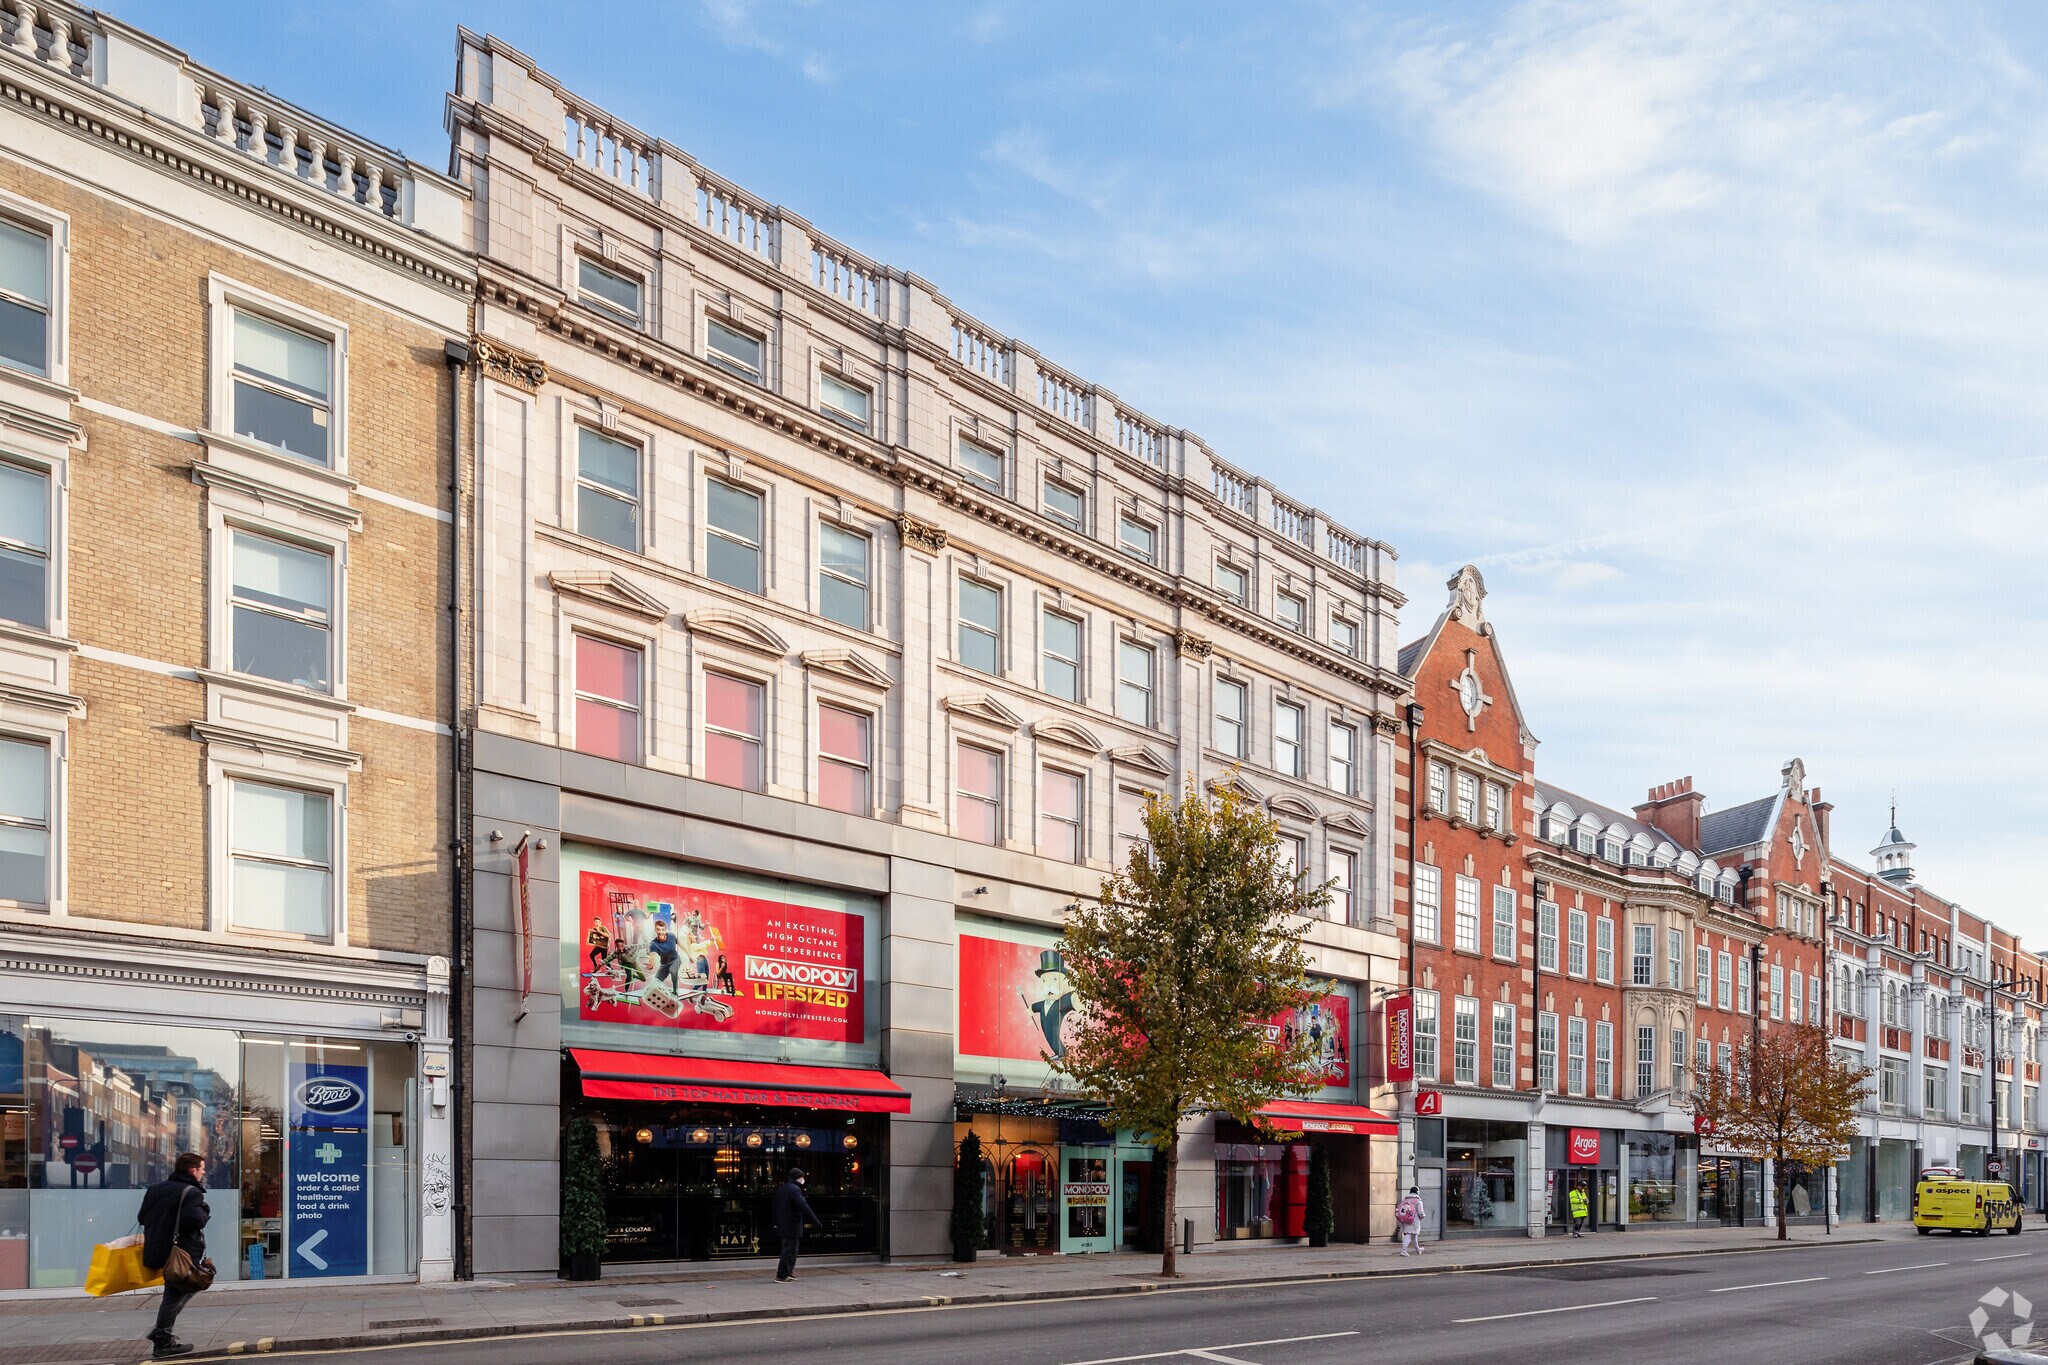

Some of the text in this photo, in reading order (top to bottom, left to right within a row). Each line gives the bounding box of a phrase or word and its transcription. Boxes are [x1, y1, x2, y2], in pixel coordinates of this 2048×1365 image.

[786, 922, 837, 937] EXCITING,
[767, 932, 838, 948] HIGH OCTANE
[780, 946, 842, 960] EXPERIENCE
[749, 959, 854, 987] MONOPOLY
[753, 983, 849, 1008] LIFESIZED
[755, 1010, 848, 1024] MONOPOLYLIFESIZED.COM
[1390, 1015, 1398, 1065] LIFESIZED
[1400, 1011, 1409, 1067] MONOPOLY
[304, 1086, 352, 1105] Boots
[652, 1086, 860, 1108] THE TOP HAT BAR & RESTAURANT
[1421, 1094, 1435, 1111] A
[1574, 1135, 1598, 1151] Argos
[296, 1172, 360, 1182] welcome
[296, 1184, 321, 1192] order
[1064, 1185, 1110, 1195] MONOPOLY
[296, 1212, 323, 1220] photo
[719, 1224, 746, 1234] TOP
[720, 1235, 747, 1245] HAT
